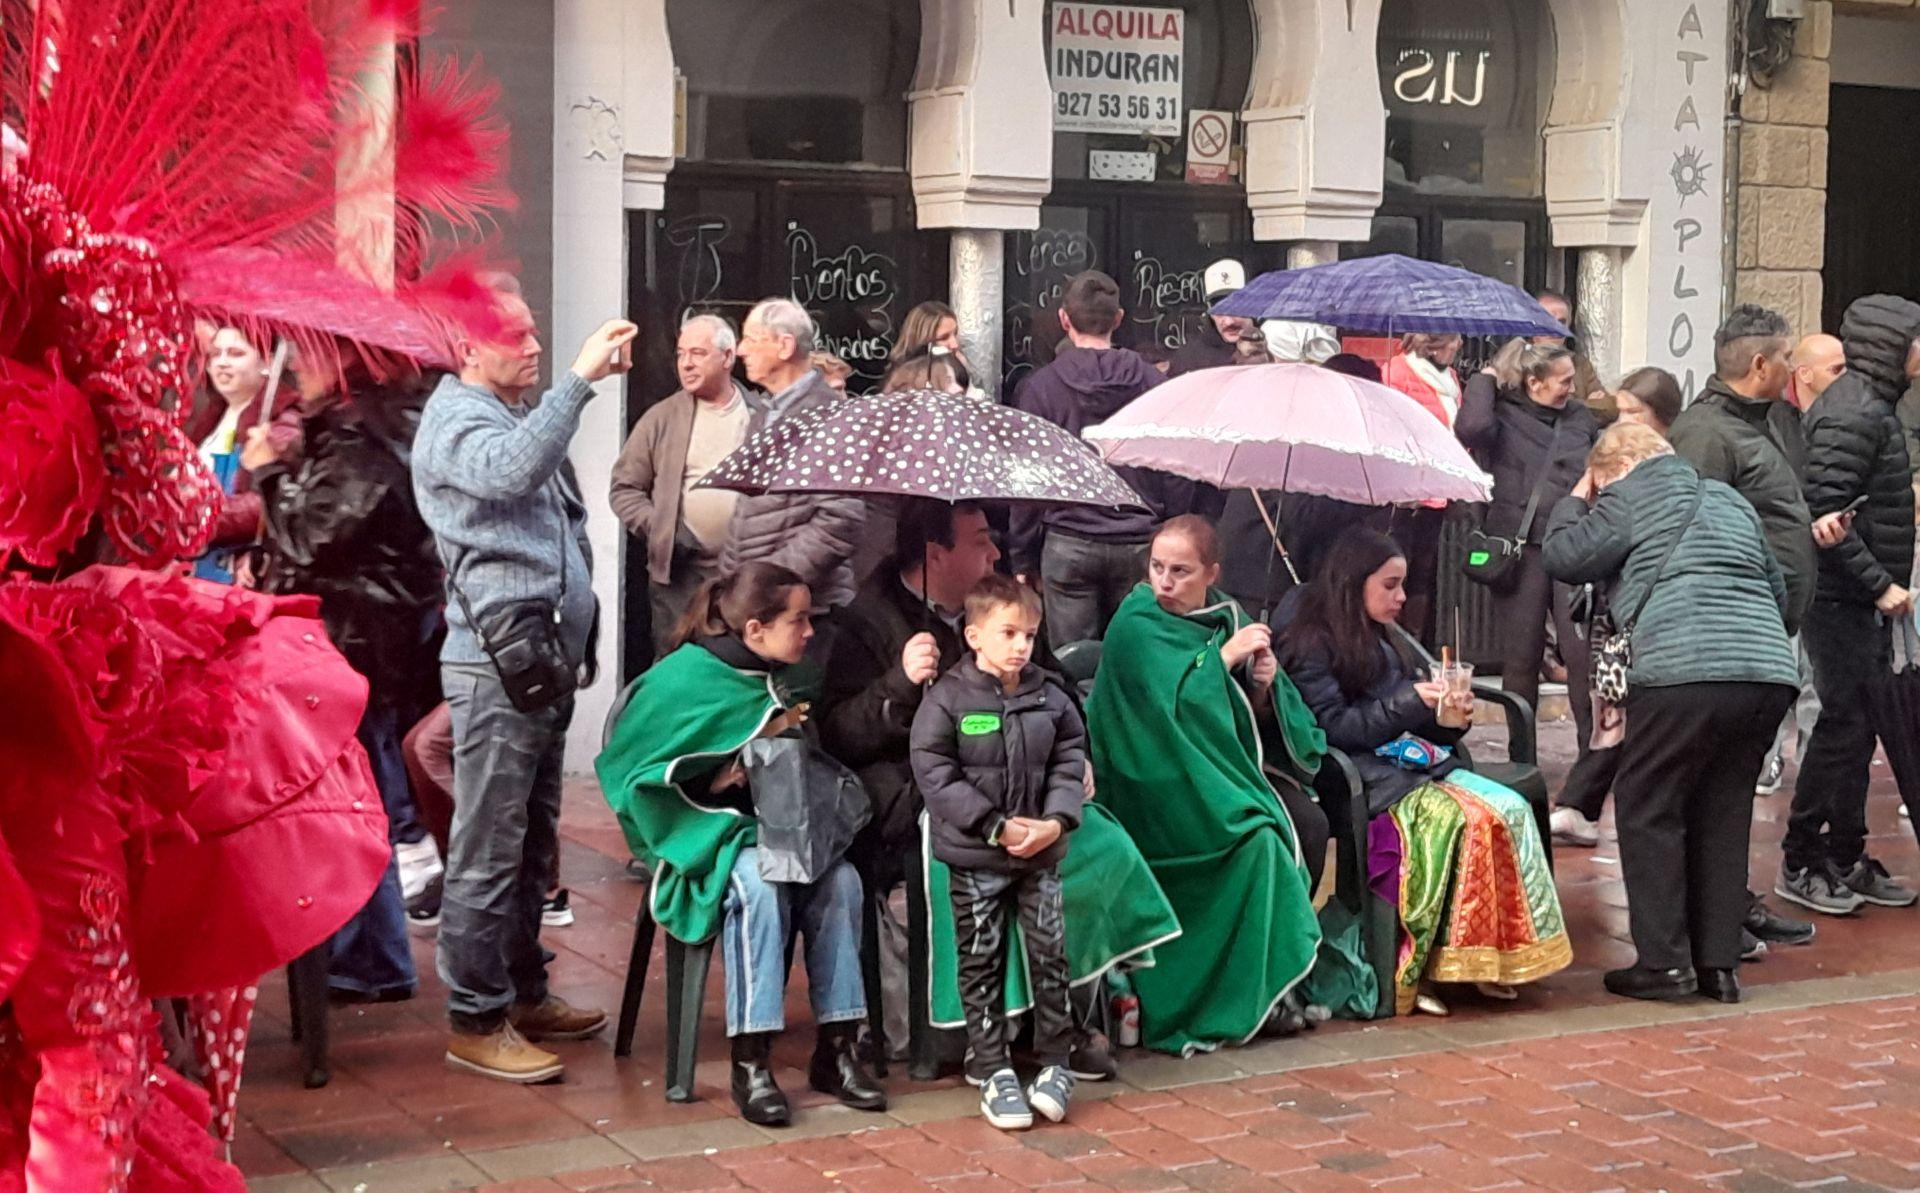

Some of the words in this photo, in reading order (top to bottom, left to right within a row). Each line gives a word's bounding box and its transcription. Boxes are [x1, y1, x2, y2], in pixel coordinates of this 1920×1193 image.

[1056, 7, 1180, 41] ALQUILA
[1056, 48, 1179, 84] INDURAN
[1057, 91, 1092, 117] 927
[1098, 94, 1121, 118] 53
[1127, 95, 1150, 119] 56
[1156, 97, 1177, 120] 31
[791, 235, 887, 307] Eventos
